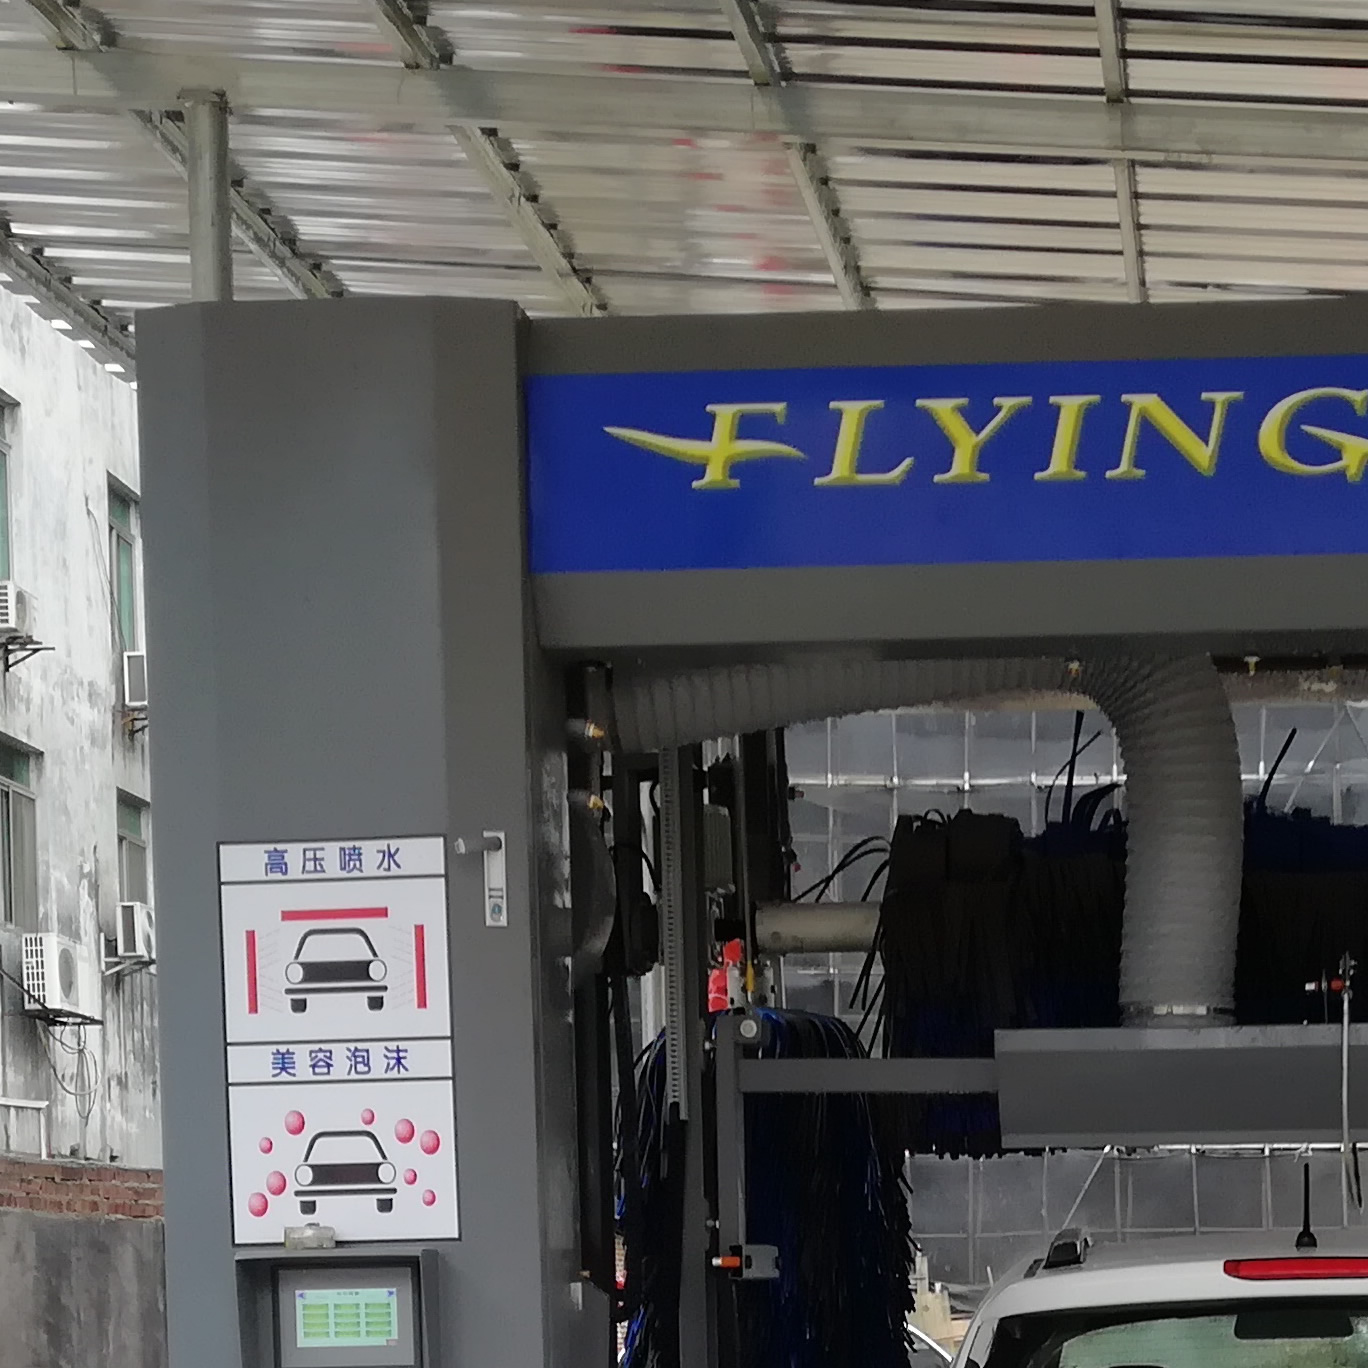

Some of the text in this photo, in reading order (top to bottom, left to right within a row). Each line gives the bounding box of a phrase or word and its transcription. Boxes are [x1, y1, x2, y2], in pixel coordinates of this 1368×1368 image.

[263, 844, 402, 877] 高压喷水
[270, 1045, 410, 1078] 美容泡沫
